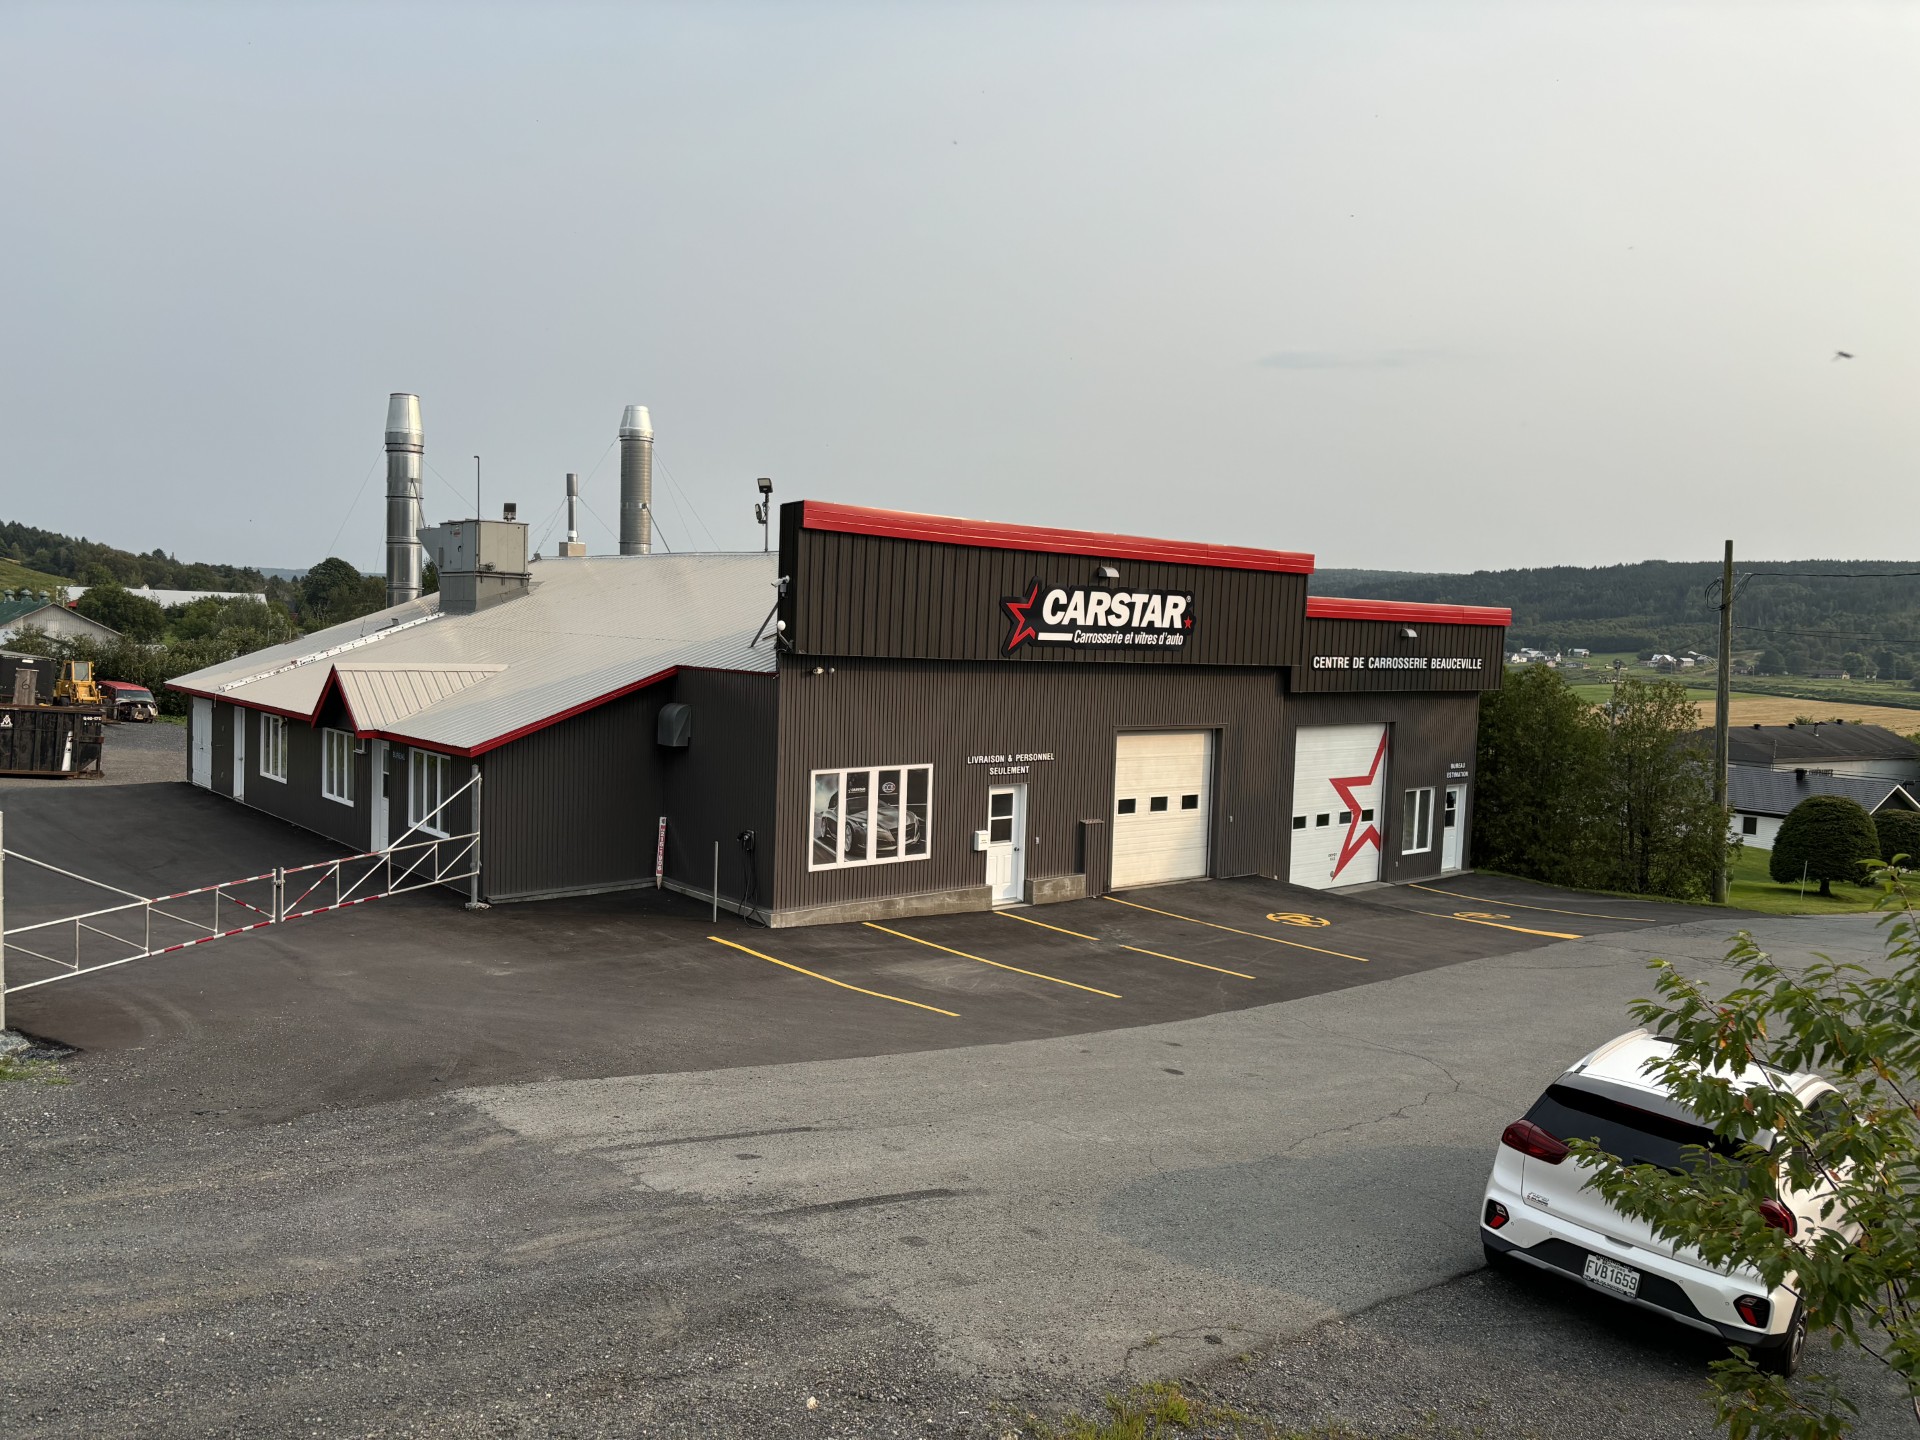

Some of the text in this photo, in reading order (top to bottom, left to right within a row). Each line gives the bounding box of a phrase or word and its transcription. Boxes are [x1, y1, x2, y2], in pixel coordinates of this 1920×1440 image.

[1042, 588, 1187, 629] CARSTAR
[1073, 629, 1184, 646] Carrosserie et vitres d'auto
[1313, 656, 1482, 670] CENTRE DE CARROSSERIE BEAUCEVILLE
[967, 753, 1055, 764] LIVRAISON & PERSONNEL
[989, 765, 1030, 775] SEULEMENT
[1585, 1259, 1638, 1291] FVB1659
